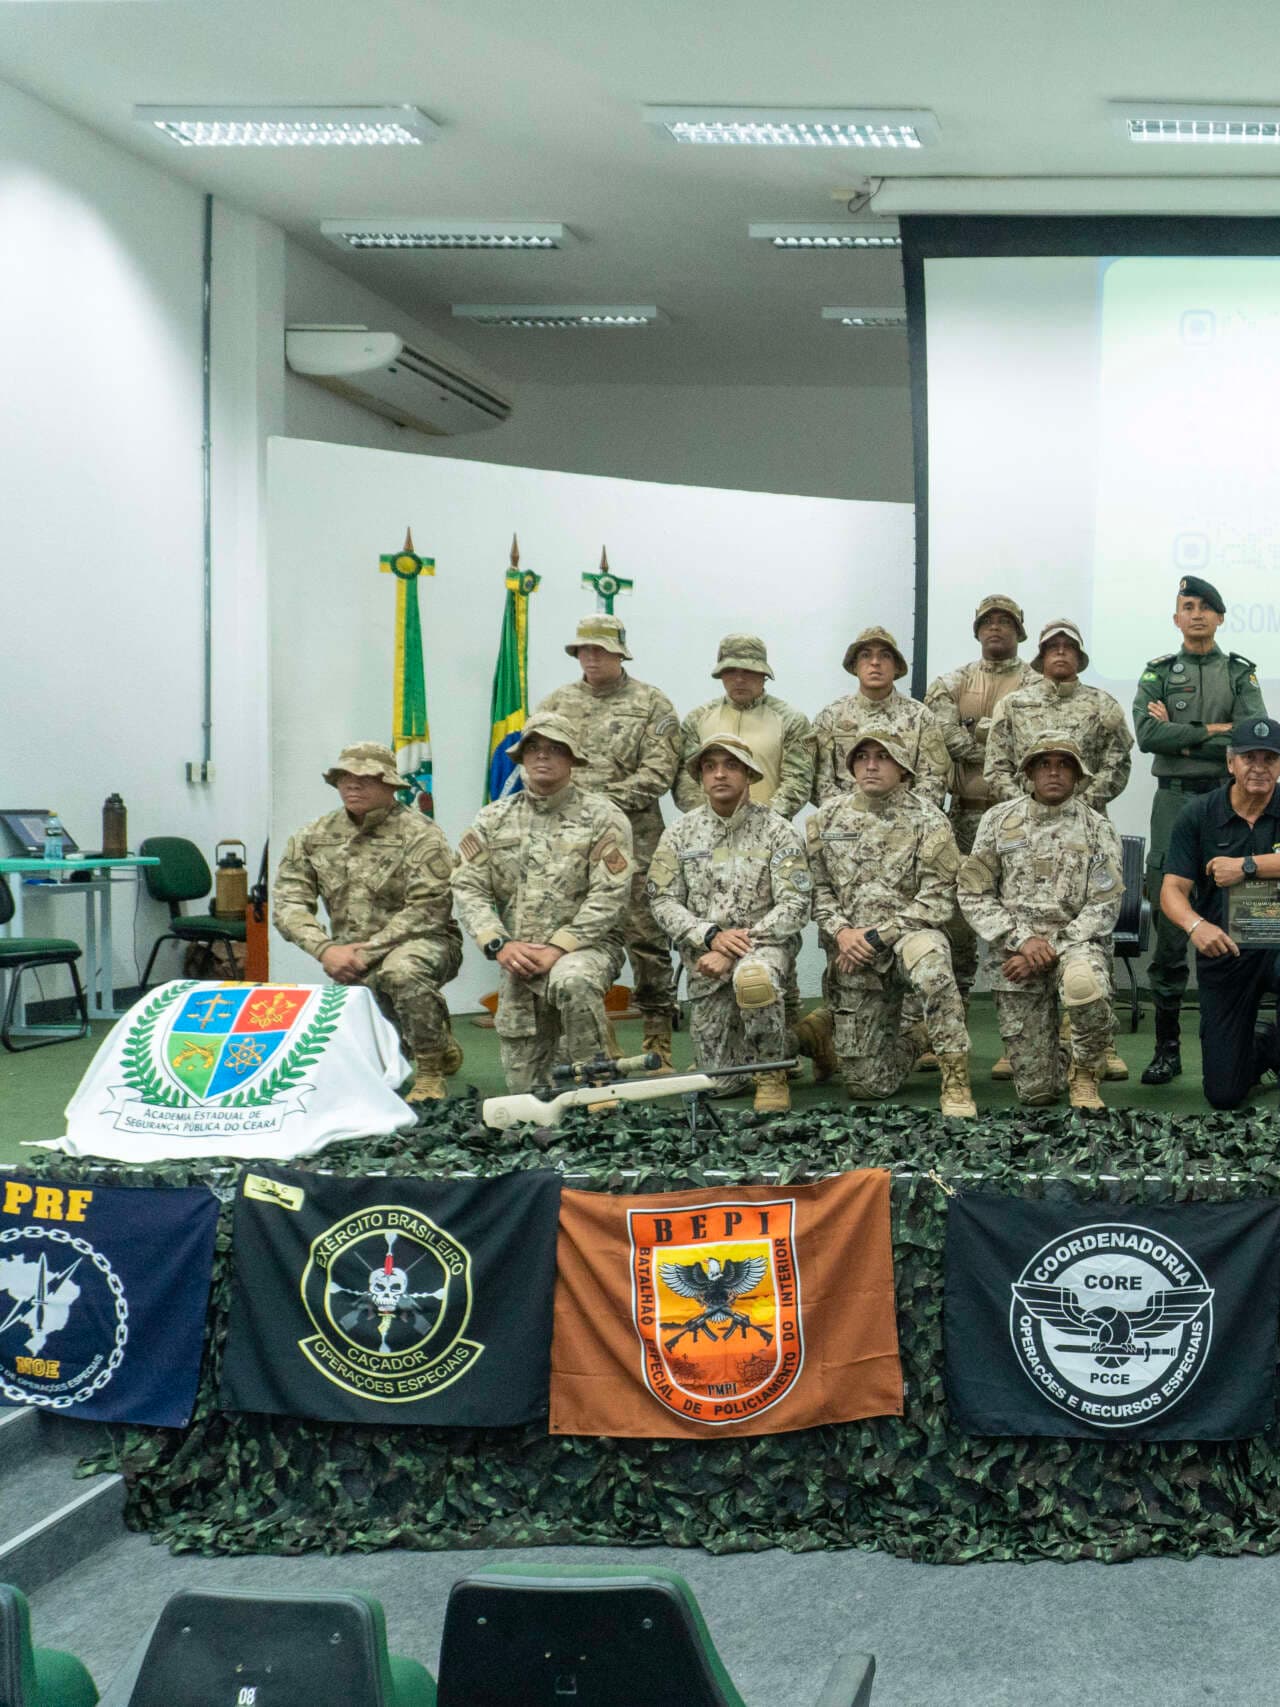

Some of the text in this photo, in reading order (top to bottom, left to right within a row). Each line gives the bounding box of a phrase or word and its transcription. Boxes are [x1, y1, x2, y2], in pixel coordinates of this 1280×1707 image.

[125, 1116, 276, 1132] SEGURANÇA PÚBLICA DO CEARÁ
[144, 1108, 262, 1121] ACADEMIA ESTADUAL DE
[3, 1181, 93, 1222] PRF
[653, 1211, 770, 1243] BEPI
[316, 1212, 464, 1276] EXÉRCITO BRASILEIRO
[1034, 1232, 1193, 1287] COORDENADORIA
[1084, 1275, 1143, 1290] CORE
[638, 1237, 796, 1417] BATALHÃO ESPECIAL DE POLICIAMENTO DO INTERIOR
[15, 1356, 60, 1379] NOE
[314, 1341, 470, 1394] OPERAÇÕES ESPECIAIS
[347, 1348, 429, 1371] CAÇADOR
[1018, 1315, 1204, 1418] OPERAÇÕES E RECURSOS ESPECIAIS
[707, 1383, 738, 1396] PMPI
[1090, 1373, 1130, 1385] PCCE
[238, 1686, 256, 1705] 08
